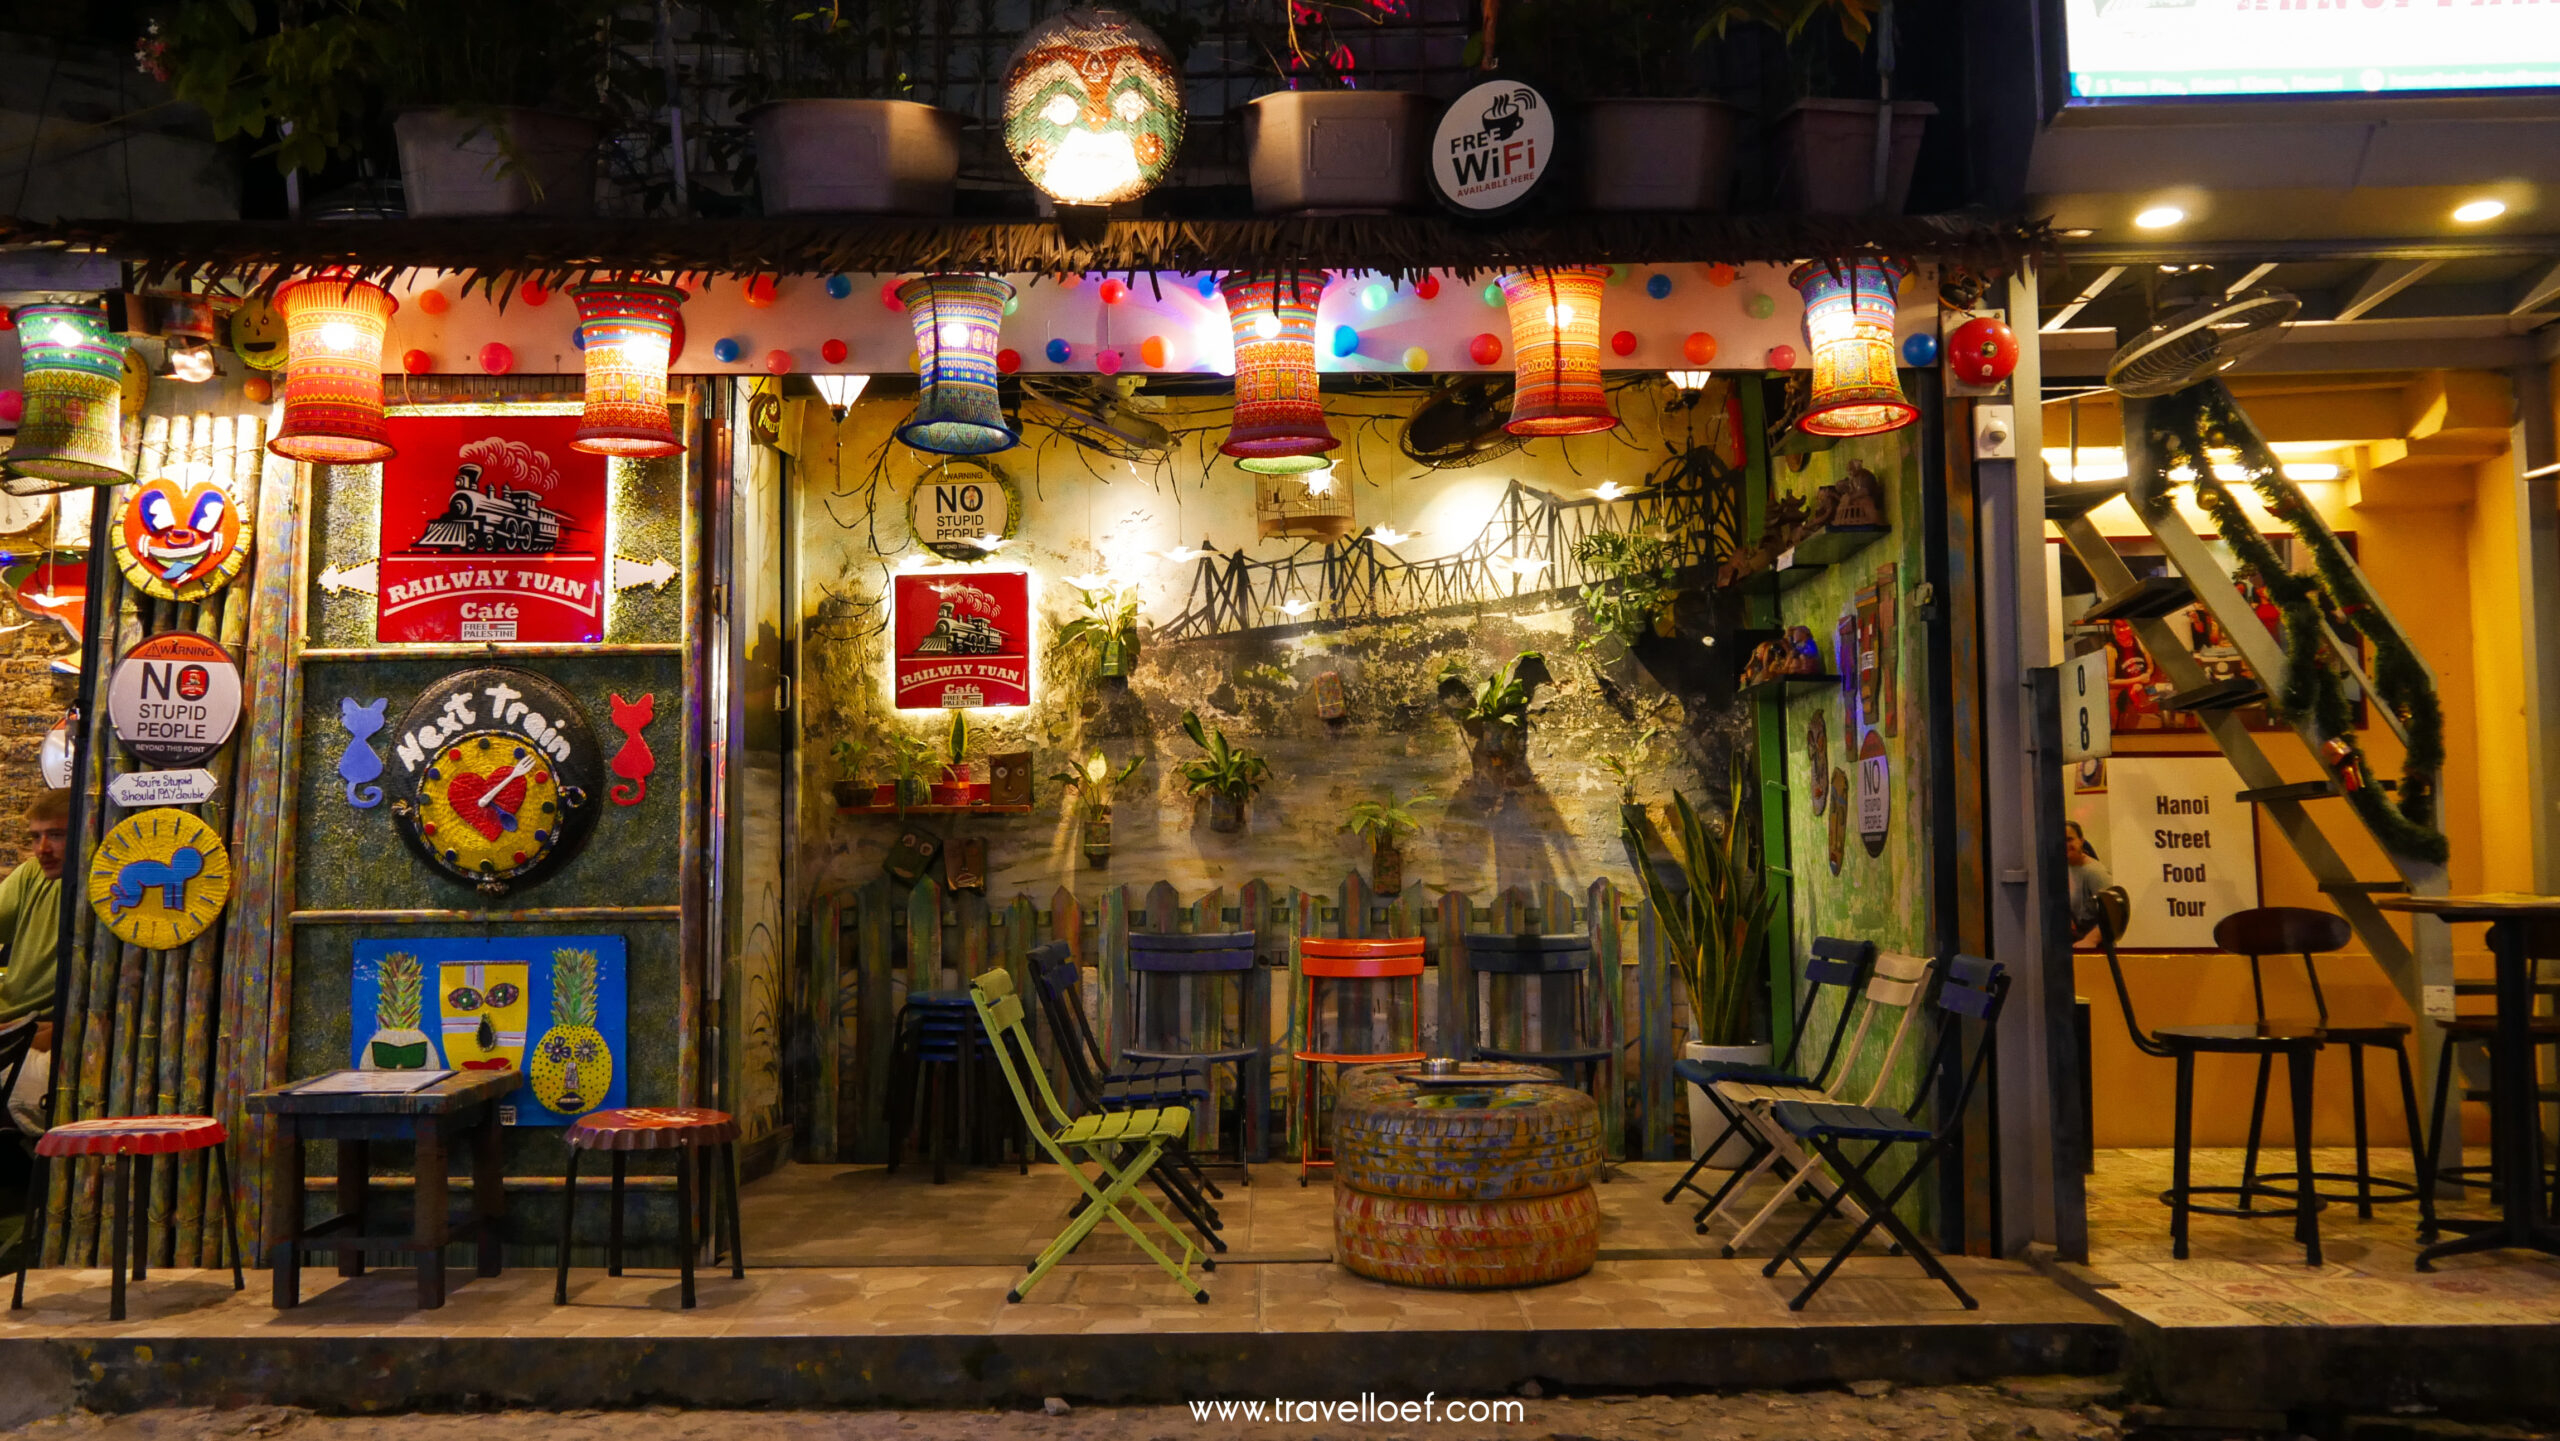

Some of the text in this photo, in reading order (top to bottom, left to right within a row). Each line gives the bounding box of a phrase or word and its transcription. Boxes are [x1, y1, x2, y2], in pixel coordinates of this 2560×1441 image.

[1450, 127, 1501, 155] FREE
[1452, 138, 1535, 187] WiFi
[1457, 172, 1535, 198] AVAILABLE HERE
[946, 472, 984, 480] WARNING
[936, 485, 984, 514] NO
[937, 515, 984, 527] STUPID
[937, 528, 985, 540] PEOPLE
[387, 569, 588, 604] RAILWAY TUAN
[460, 602, 520, 620] Café
[463, 631, 516, 639] PALESTINE
[464, 623, 488, 631] FREE
[160, 646, 215, 657] WARNING
[140, 662, 210, 701] NO
[901, 665, 1019, 686] RAILWAY TUAN
[945, 683, 980, 694] Café
[139, 703, 207, 720] STUPID
[137, 722, 206, 739] PEOPLE
[396, 682, 571, 772] Next Train
[135, 743, 165, 751] BEYOND
[1863, 759, 1881, 796] NO
[121, 789, 156, 801] Should
[176, 788, 205, 800] double
[2156, 795, 2209, 815] Hanoi
[2154, 830, 2211, 849] Street
[2163, 863, 2206, 883] Food
[2166, 898, 2206, 917] Tour
